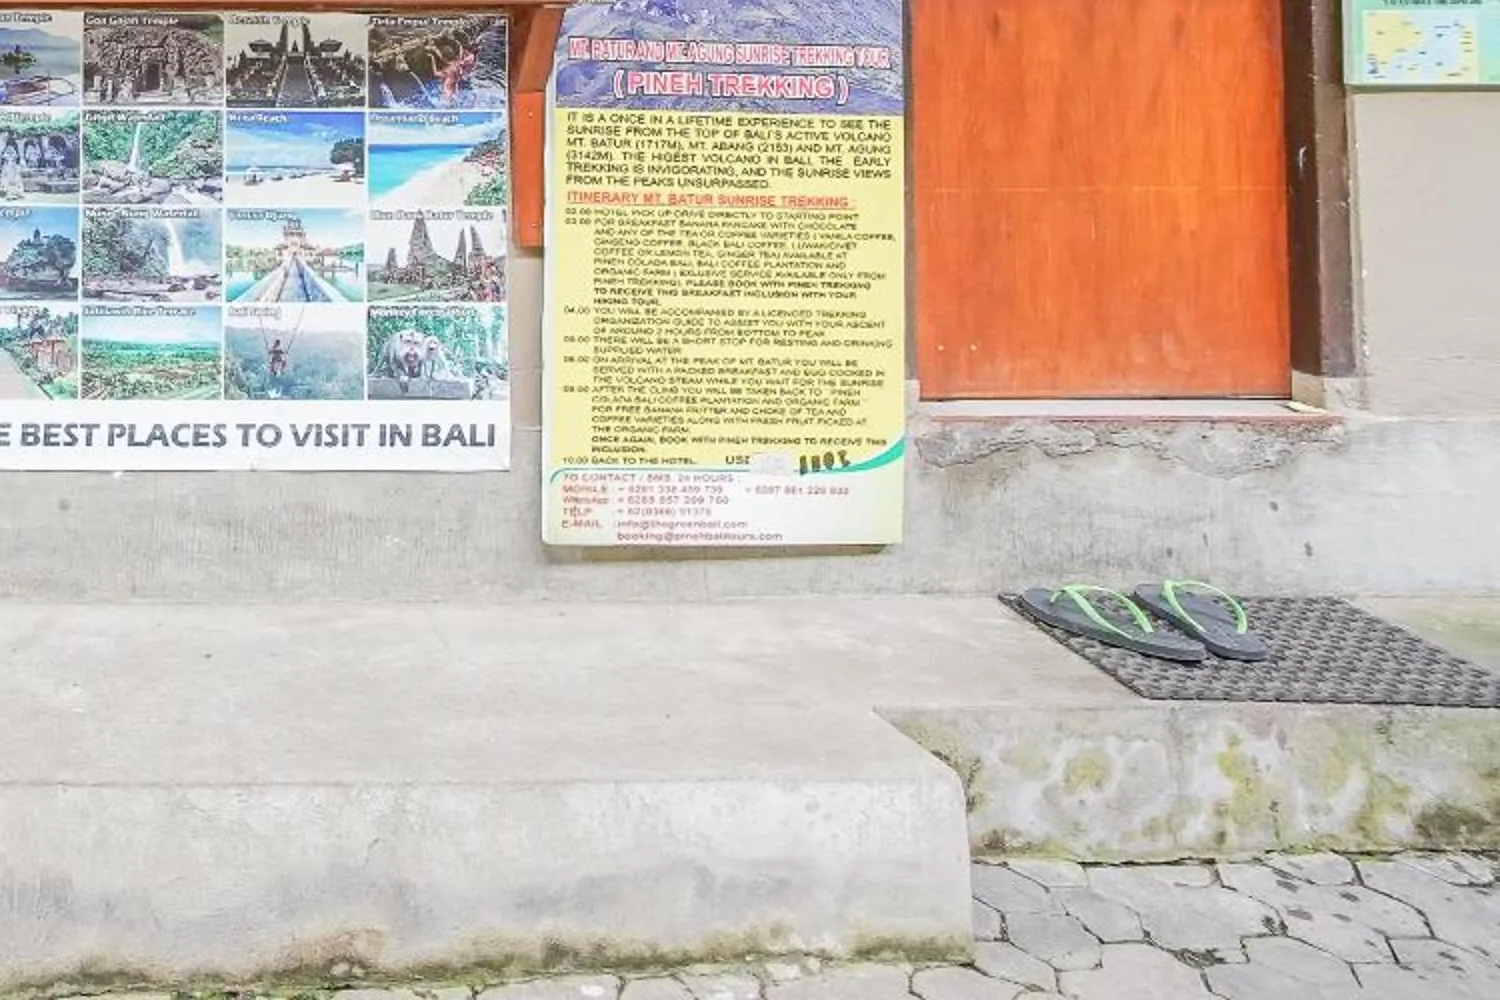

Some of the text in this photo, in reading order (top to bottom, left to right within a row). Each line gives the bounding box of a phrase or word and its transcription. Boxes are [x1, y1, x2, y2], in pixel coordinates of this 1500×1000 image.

[609, 114, 645, 124] ONCE
[677, 115, 733, 126] LIFETIME
[737, 117, 815, 129] EXPERIENCE
[566, 191, 639, 202] ITINERARY
[19, 422, 100, 448] BEST
[106, 422, 228, 449] PLACES
[235, 422, 283, 449] TO
[291, 422, 371, 449] VISIT
[378, 423, 414, 449] IN
[420, 423, 497, 449] BALI
